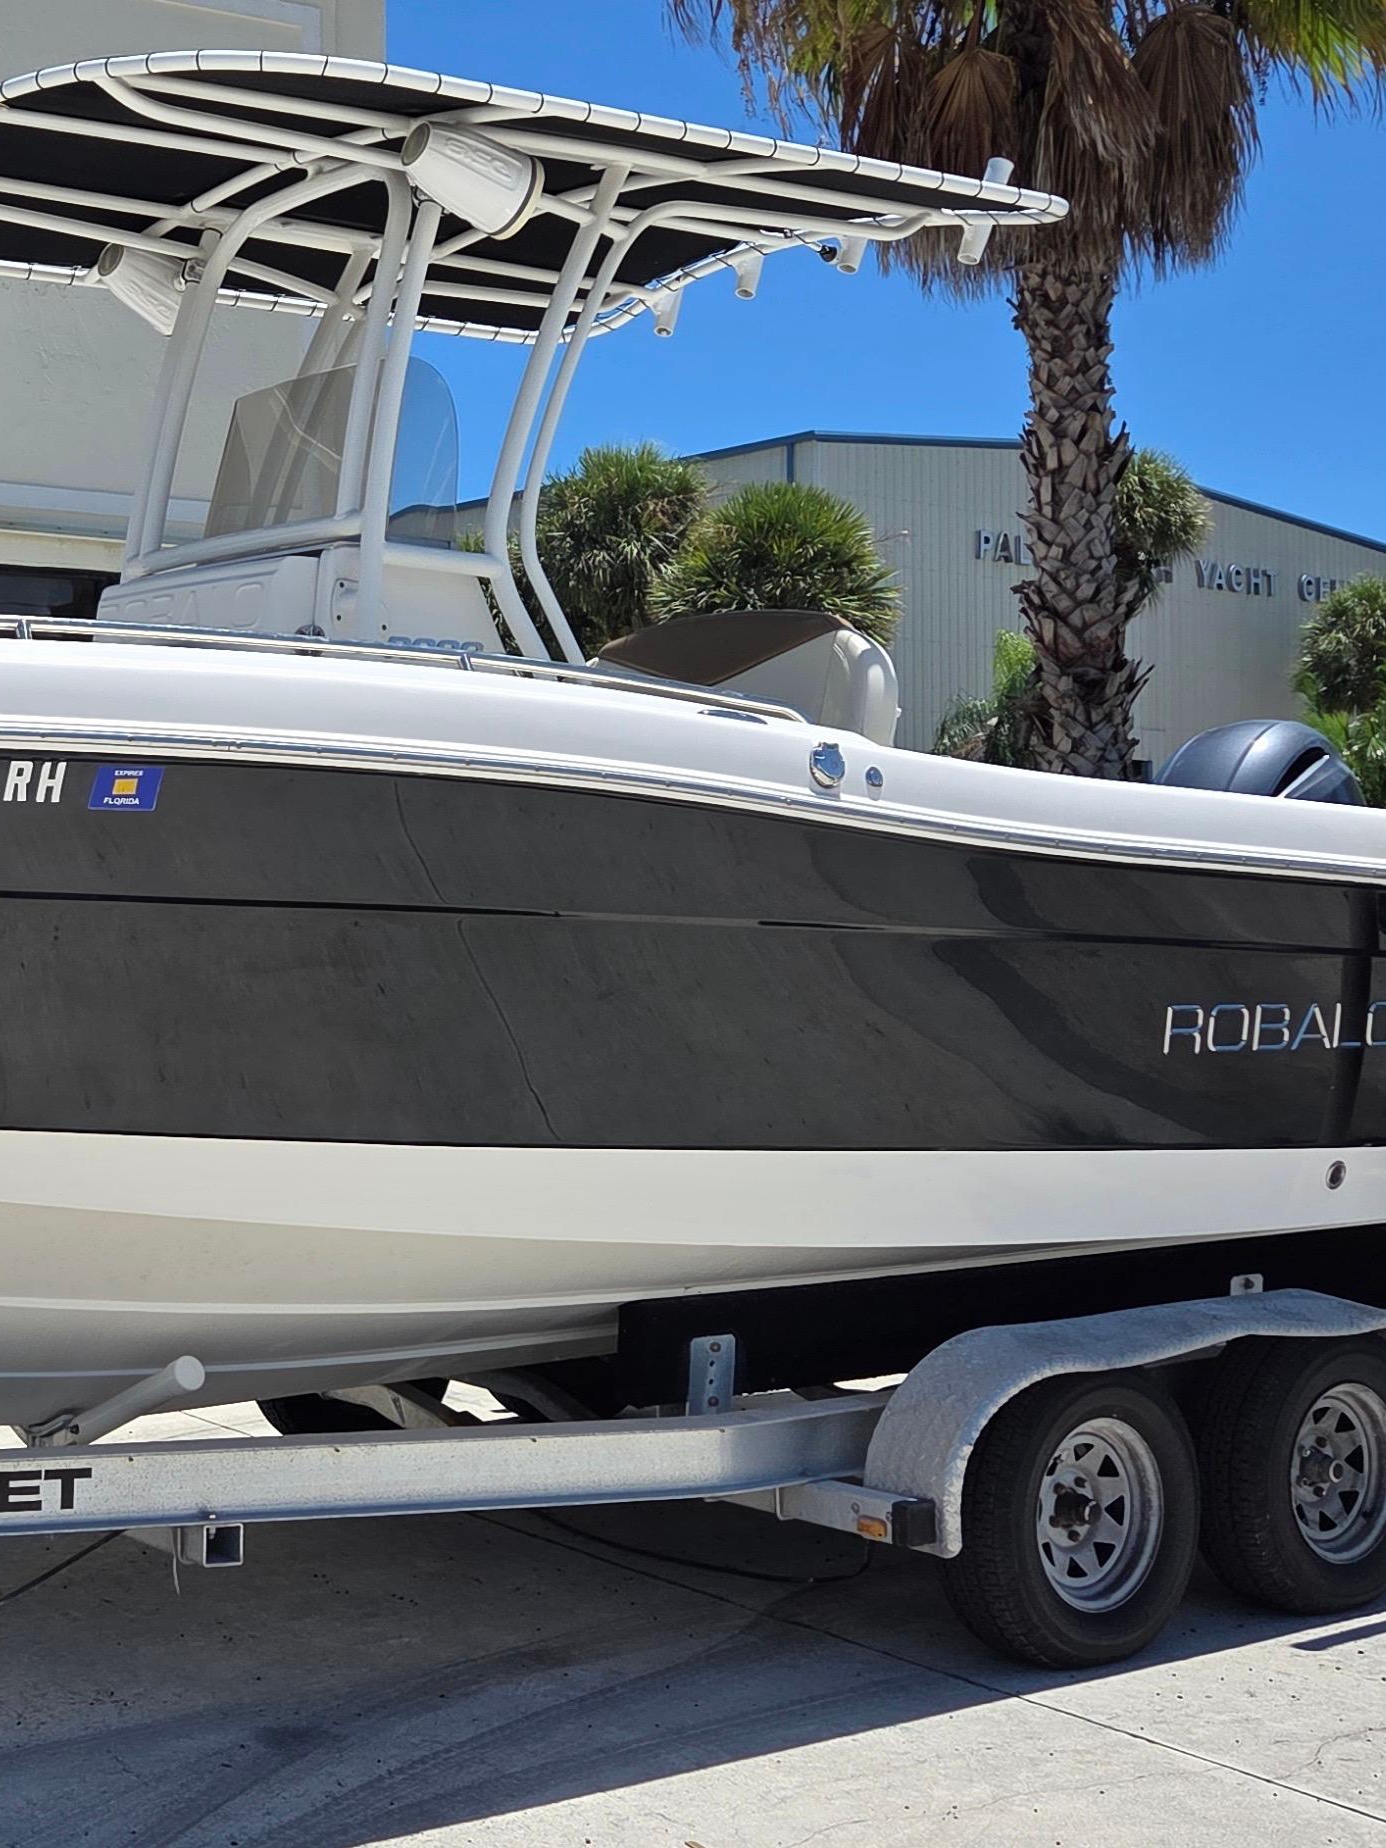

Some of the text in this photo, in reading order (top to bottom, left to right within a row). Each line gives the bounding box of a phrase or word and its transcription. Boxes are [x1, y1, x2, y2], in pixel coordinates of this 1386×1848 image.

[975, 529, 1032, 565] PAL
[1195, 559, 1278, 596] YACHT
[3, 760, 67, 803] RH
[103, 796, 140, 806] FLORIDA
